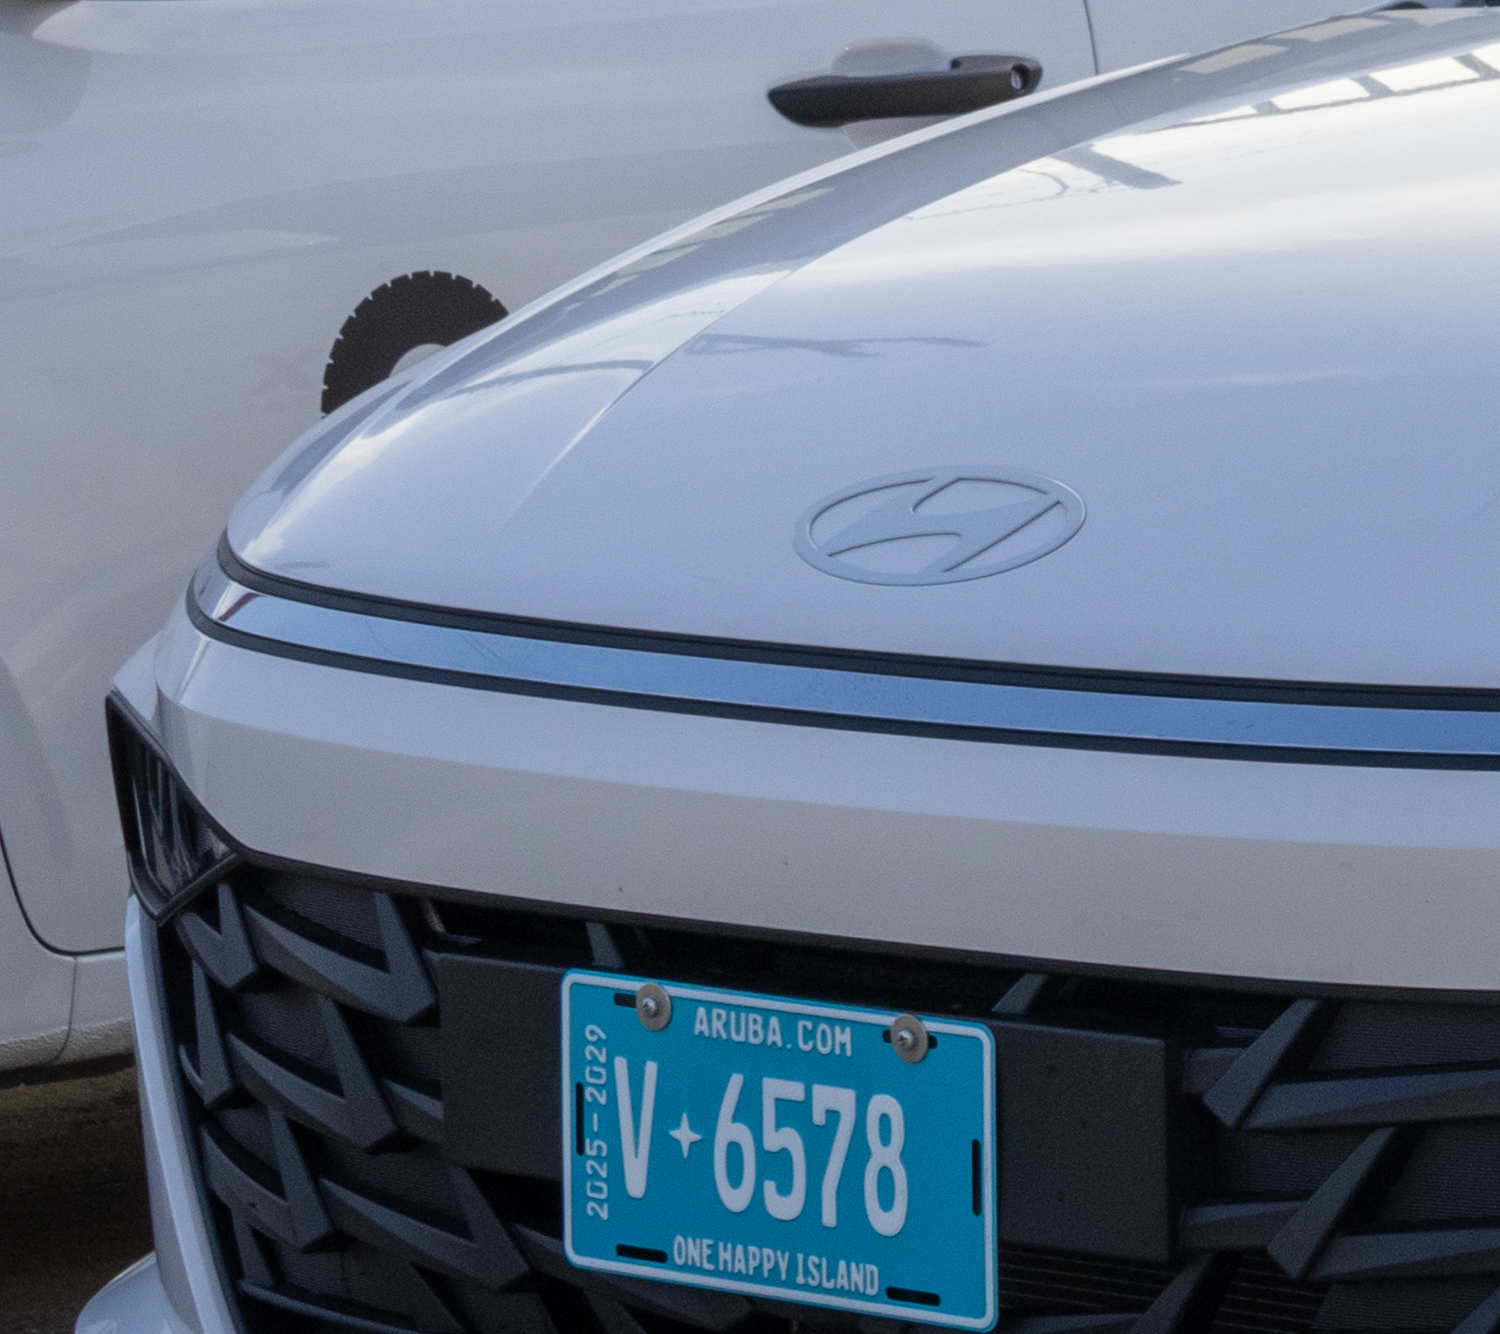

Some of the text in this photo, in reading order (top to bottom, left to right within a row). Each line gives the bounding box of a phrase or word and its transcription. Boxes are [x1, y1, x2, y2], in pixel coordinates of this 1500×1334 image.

[672, 1234, 880, 1297] ONE HAPPY ISLAND
